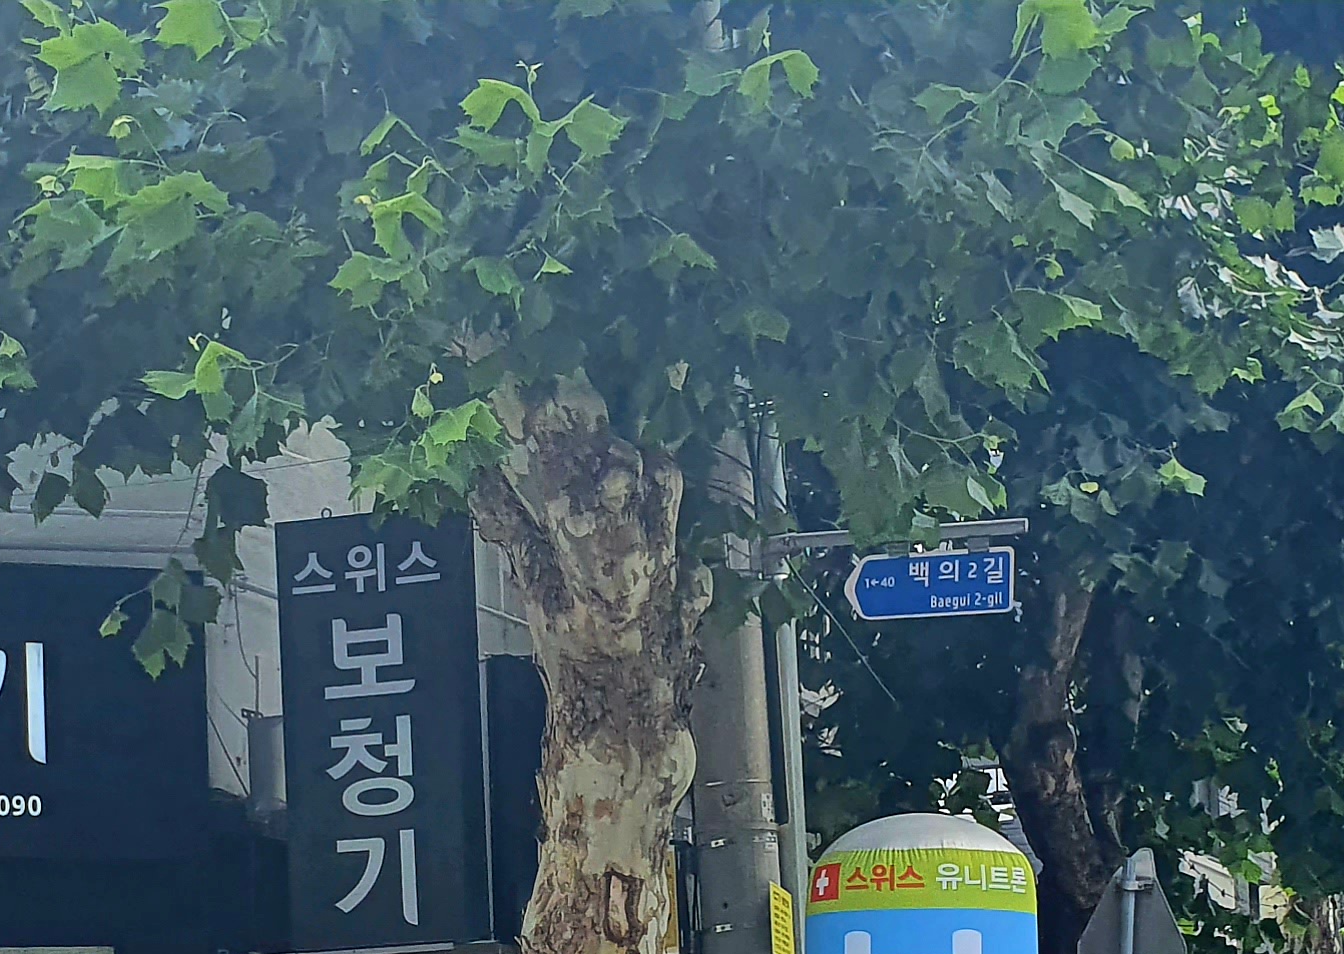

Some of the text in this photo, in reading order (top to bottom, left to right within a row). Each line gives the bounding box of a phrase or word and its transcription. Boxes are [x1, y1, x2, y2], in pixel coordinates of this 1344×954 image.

[291, 544, 442, 597] 스위스
[930, 591, 1003, 610] Baegui 2-gil
[324, 612, 420, 927] 보청기
[845, 862, 1028, 894] 스위스 유니트론
